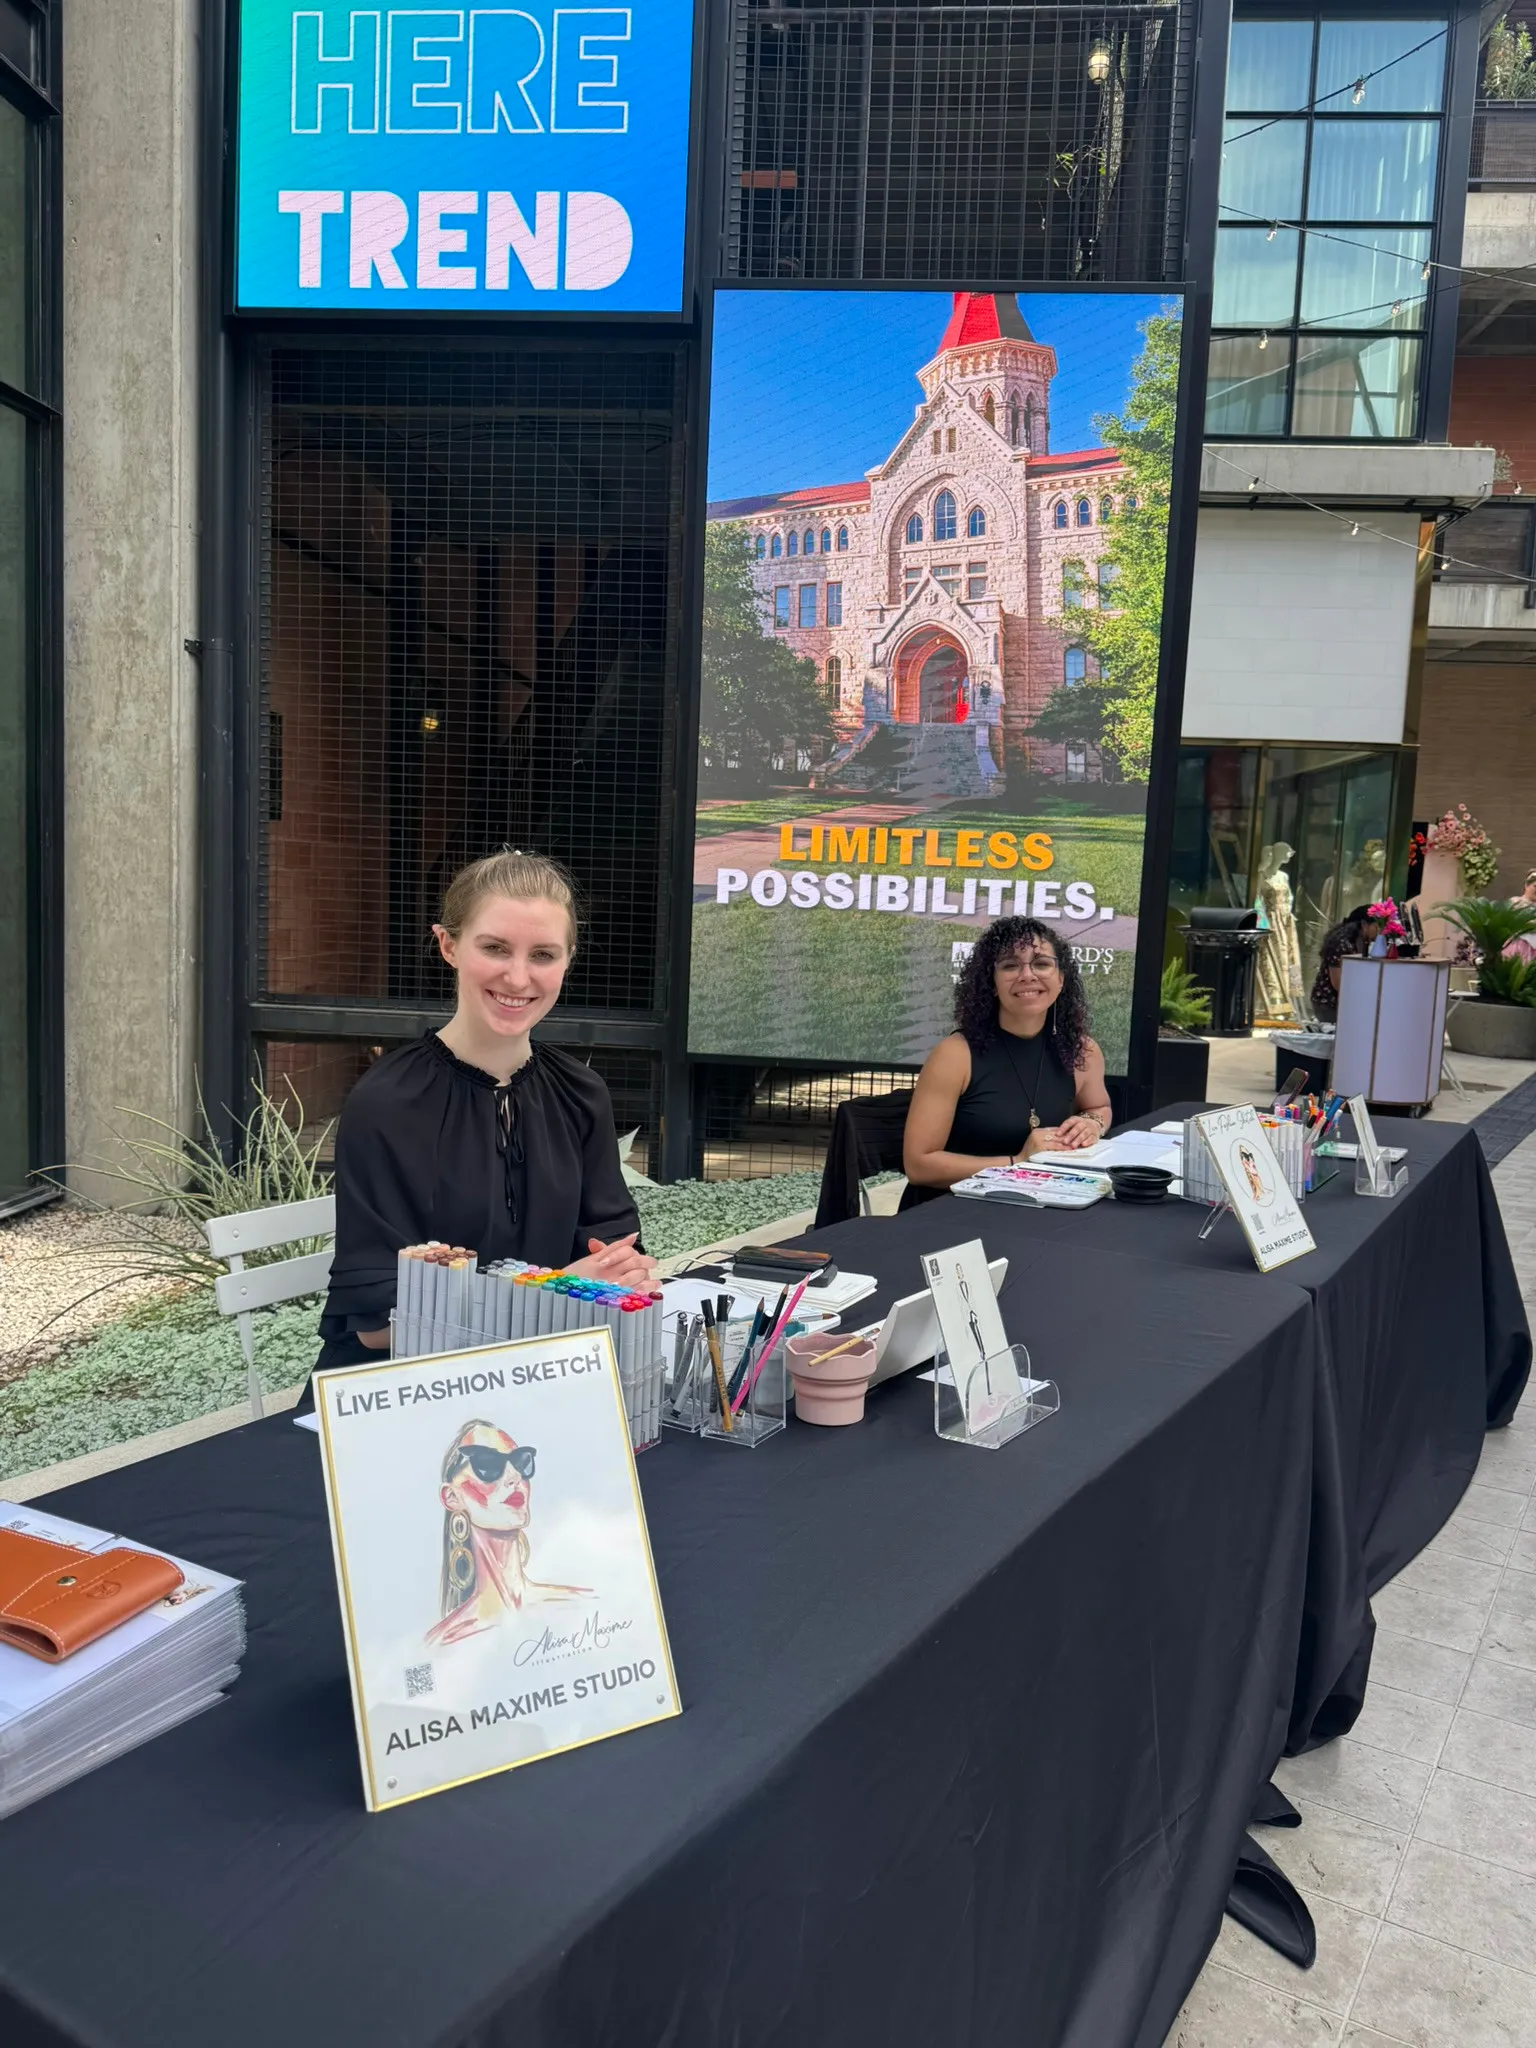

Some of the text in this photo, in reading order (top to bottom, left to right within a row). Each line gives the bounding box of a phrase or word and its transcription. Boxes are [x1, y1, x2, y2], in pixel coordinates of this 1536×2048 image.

[291, 8, 631, 134] HERE
[278, 190, 633, 290] TREND
[779, 823, 1054, 870] LIMITLESS
[716, 868, 1114, 920] POSSIBILITIES.
[336, 1352, 602, 1417] LIVE FASHION SKETCH
[513, 1610, 633, 1667] Alisa Maxime
[385, 1659, 657, 1755] ALISA MAXIME STUDIO
